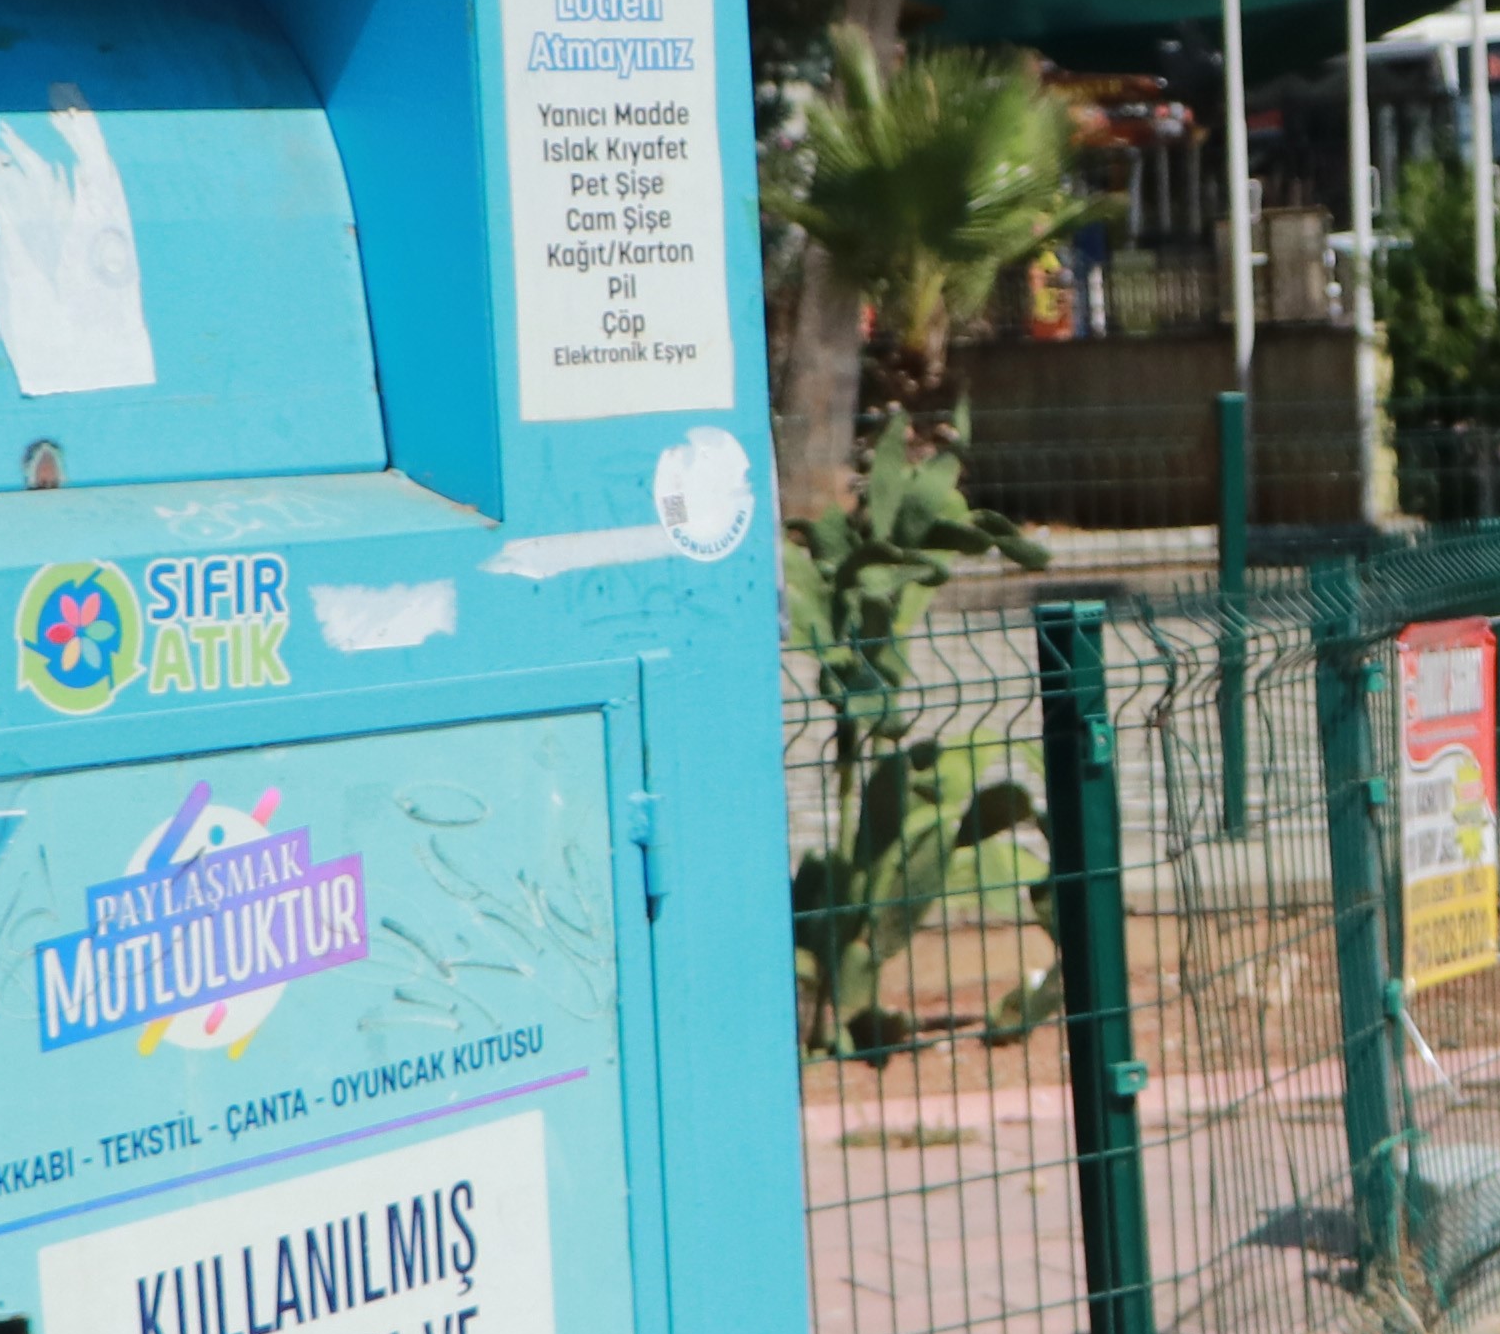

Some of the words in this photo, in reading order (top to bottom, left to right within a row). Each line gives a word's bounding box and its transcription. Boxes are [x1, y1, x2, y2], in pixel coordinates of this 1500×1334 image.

[528, 31, 694, 79] Atmayınız
[538, 102, 606, 127] Yanıcı
[614, 99, 690, 126] Madde
[543, 136, 598, 163] Islak
[607, 135, 688, 166] Kıyafet
[570, 172, 610, 196] Pet
[615, 169, 665, 200] Şişe
[566, 207, 617, 232] Cam
[622, 203, 672, 235] Şişe
[546, 239, 695, 273] Kağıt/Karton
[607, 273, 637, 299] Pil
[602, 308, 646, 340] Çöp
[553, 340, 649, 367] Elektronik
[653, 341, 697, 364] Eşya
[148, 556, 287, 620] SIFIR
[149, 619, 290, 693] ATIK
[94, 839, 305, 937] PAYLAŞMAK
[42, 873, 362, 1040] MUTLULUKTUR
[98, 1107, 203, 1171] TEKSTİL
[225, 1088, 310, 1140] ÇANTA
[331, 1048, 447, 1109] OYUNCAK
[452, 1023, 545, 1075] KUTUSU
